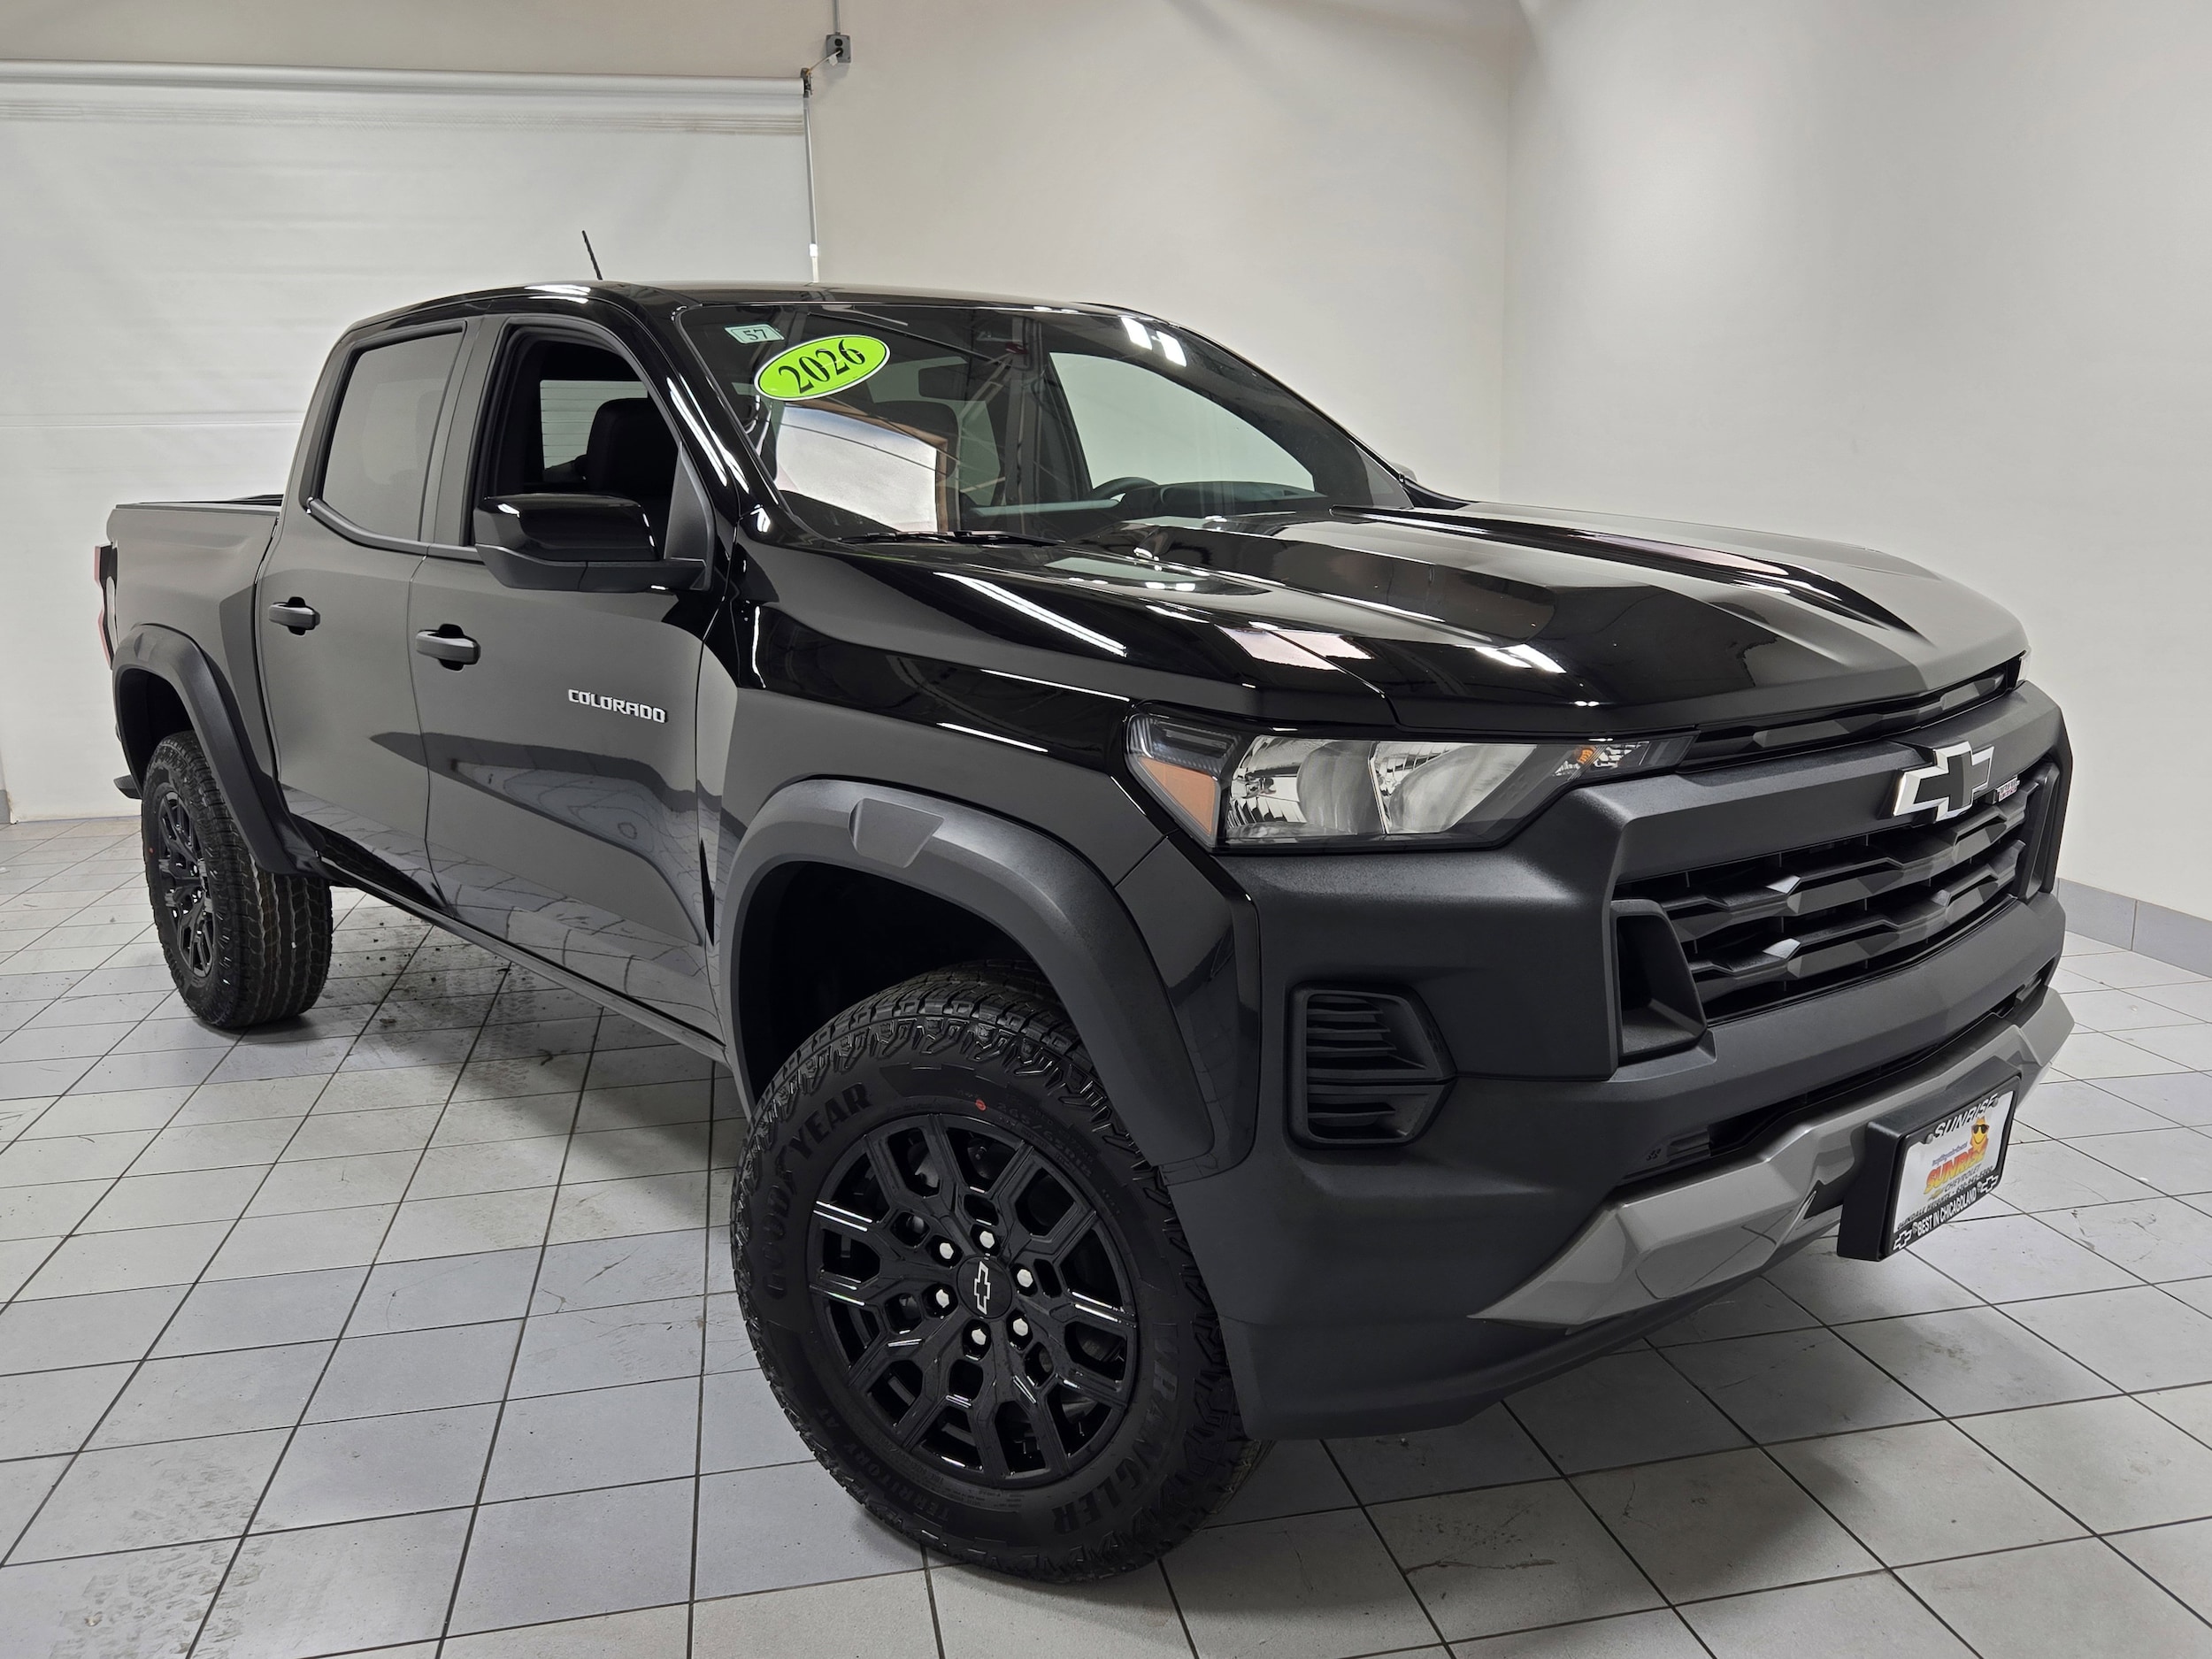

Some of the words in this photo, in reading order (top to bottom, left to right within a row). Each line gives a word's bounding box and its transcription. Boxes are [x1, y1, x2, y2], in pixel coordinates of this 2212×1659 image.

[742, 328, 768, 341] 57
[778, 338, 866, 395] 2026
[567, 688, 667, 724] COLORADO
[1933, 1092, 1999, 1139] SUNRISE
[1923, 1145, 1988, 1195] SUNRISE
[1945, 1163, 1982, 1193] CHEVROLET
[1917, 1213, 1933, 1236] BEST
[1932, 1210, 1941, 1227] IN
[1940, 1186, 1978, 1225] CHICAGOLAND
[1051, 1322, 1180, 1536] WRANGLER
[843, 1442, 951, 1523] TERRITORY
